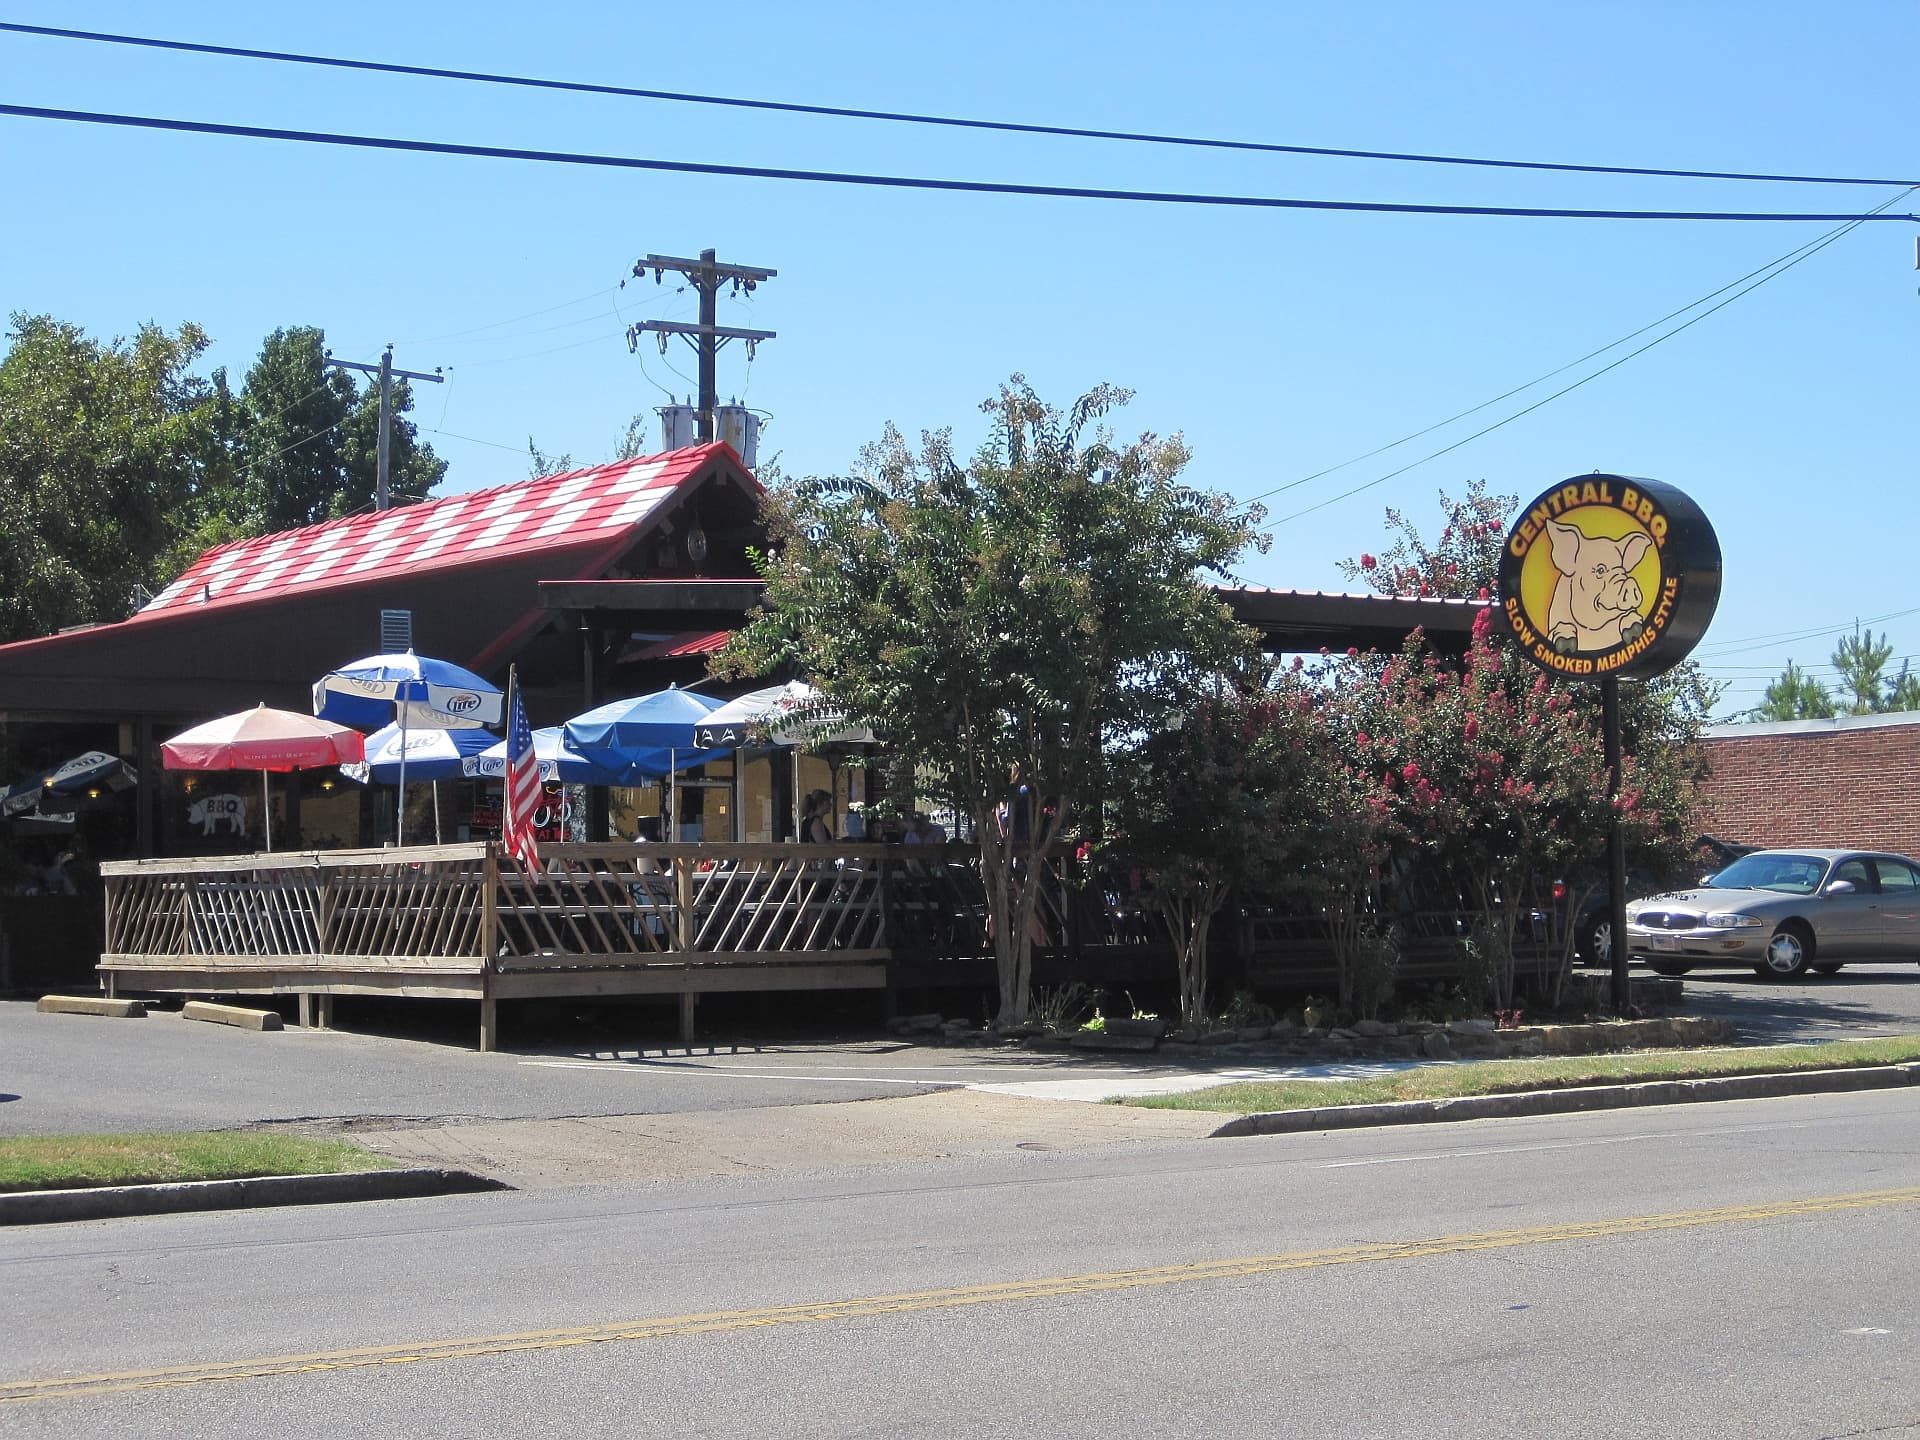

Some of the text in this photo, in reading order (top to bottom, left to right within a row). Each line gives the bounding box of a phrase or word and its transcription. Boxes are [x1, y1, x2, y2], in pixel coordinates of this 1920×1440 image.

[1510, 482, 1669, 557] CENTRAL BBQ
[1505, 576, 1678, 674] SLOW SMOKED MEMPHIS STYLE
[453, 700, 477, 712] Lite
[206, 800, 238, 813] BBQ
